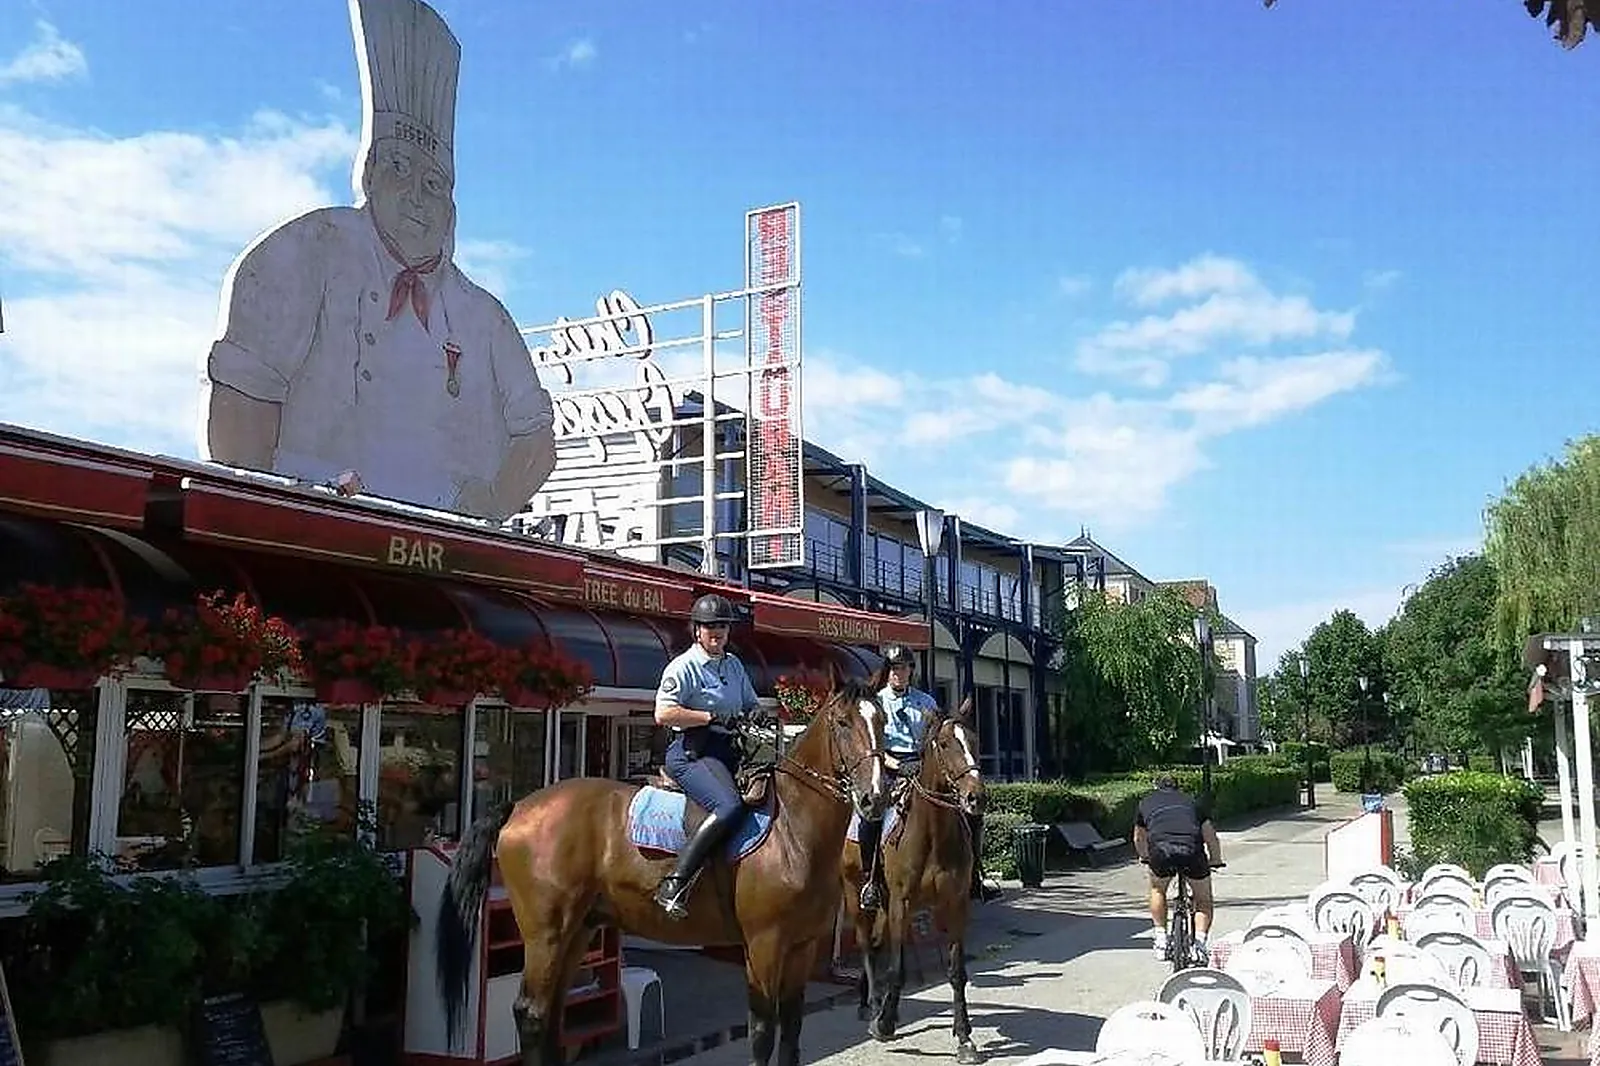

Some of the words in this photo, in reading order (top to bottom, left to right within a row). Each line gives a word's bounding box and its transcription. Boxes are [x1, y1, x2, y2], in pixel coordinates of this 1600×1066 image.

[387, 535, 446, 572] BAR
[584, 578, 618, 606] TREE
[623, 588, 641, 609] du
[643, 587, 668, 612] BAL
[817, 615, 882, 642] RESTAURANT
